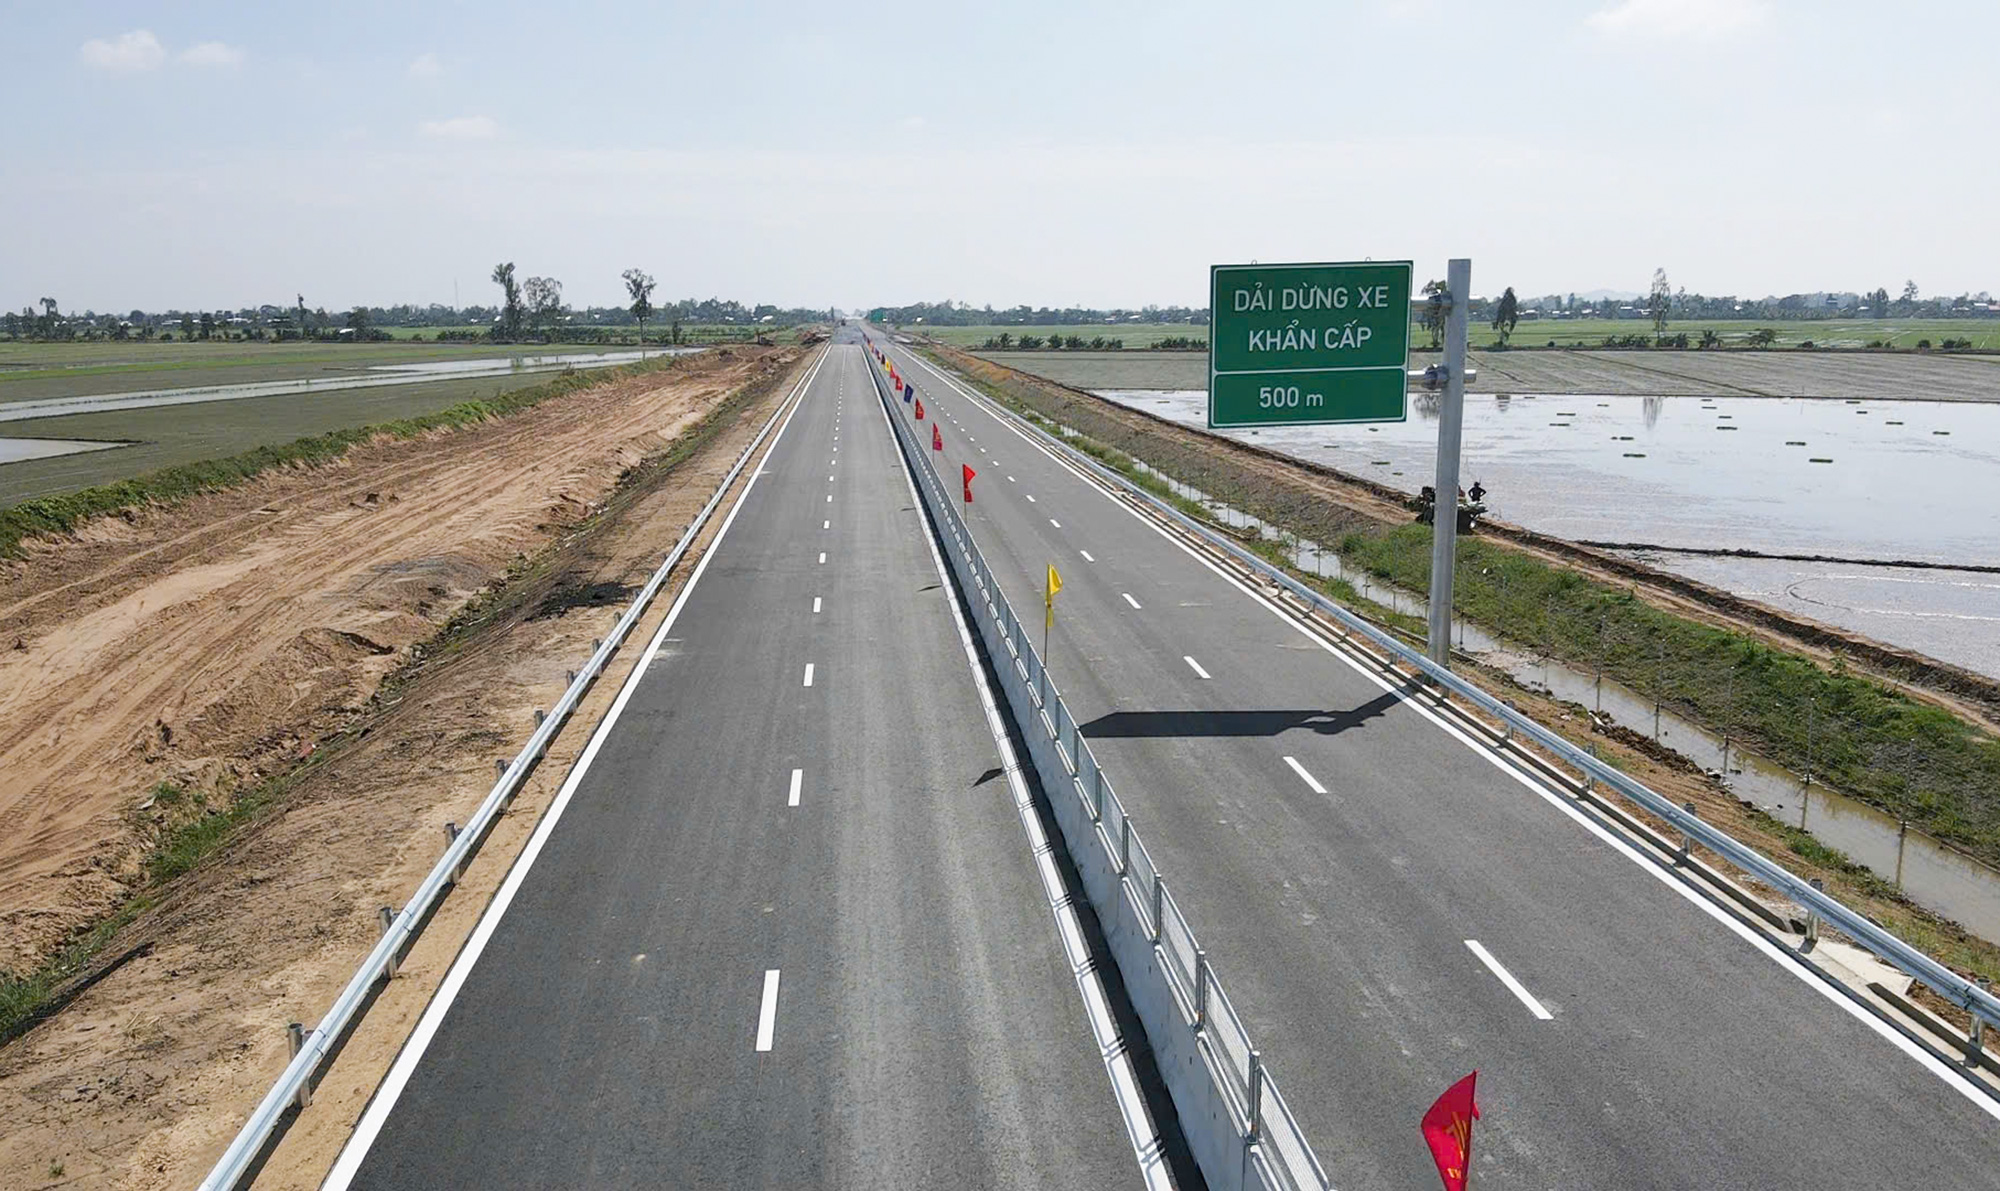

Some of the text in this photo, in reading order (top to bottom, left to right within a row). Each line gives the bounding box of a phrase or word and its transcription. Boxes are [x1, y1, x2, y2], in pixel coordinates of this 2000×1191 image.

[1234, 282, 1389, 312] DẢI DỪNG XE
[1248, 319, 1372, 352] KHẨN CẤP
[1259, 387, 1323, 408] 500 m
